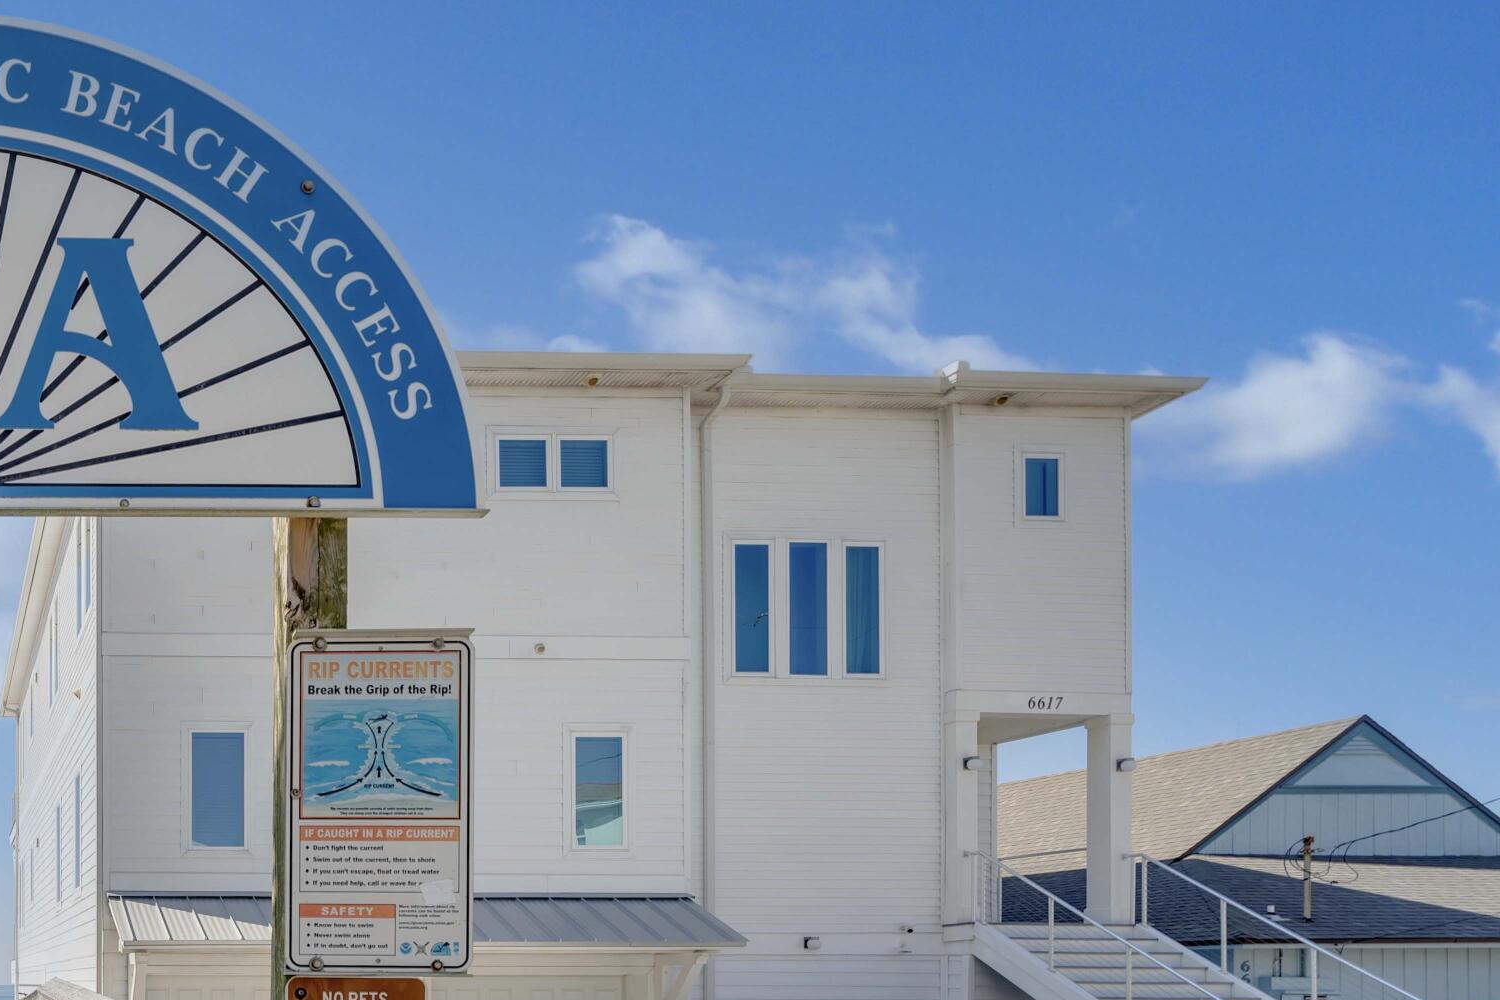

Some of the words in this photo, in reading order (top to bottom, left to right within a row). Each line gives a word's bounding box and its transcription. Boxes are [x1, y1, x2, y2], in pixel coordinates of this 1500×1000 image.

[62, 73, 269, 203] BEACH
[271, 207, 434, 421] ACCESS
[307, 660, 340, 679] RIP
[347, 660, 454, 679] CURRENTS
[308, 685, 340, 695] Break
[344, 685, 362, 695] the
[366, 685, 389, 697] Grip
[393, 685, 405, 695] of
[408, 685, 426, 695] the
[430, 684, 452, 696] Rip!
[1028, 696, 1064, 710] 6617
[305, 829, 314, 838] IF
[317, 829, 360, 838] CAUGHT
[362, 829, 373, 838] IN
[376, 829, 384, 838] A
[386, 829, 403, 838] RIP
[406, 829, 455, 838] CURRENT
[321, 907, 374, 916] SAFETY
